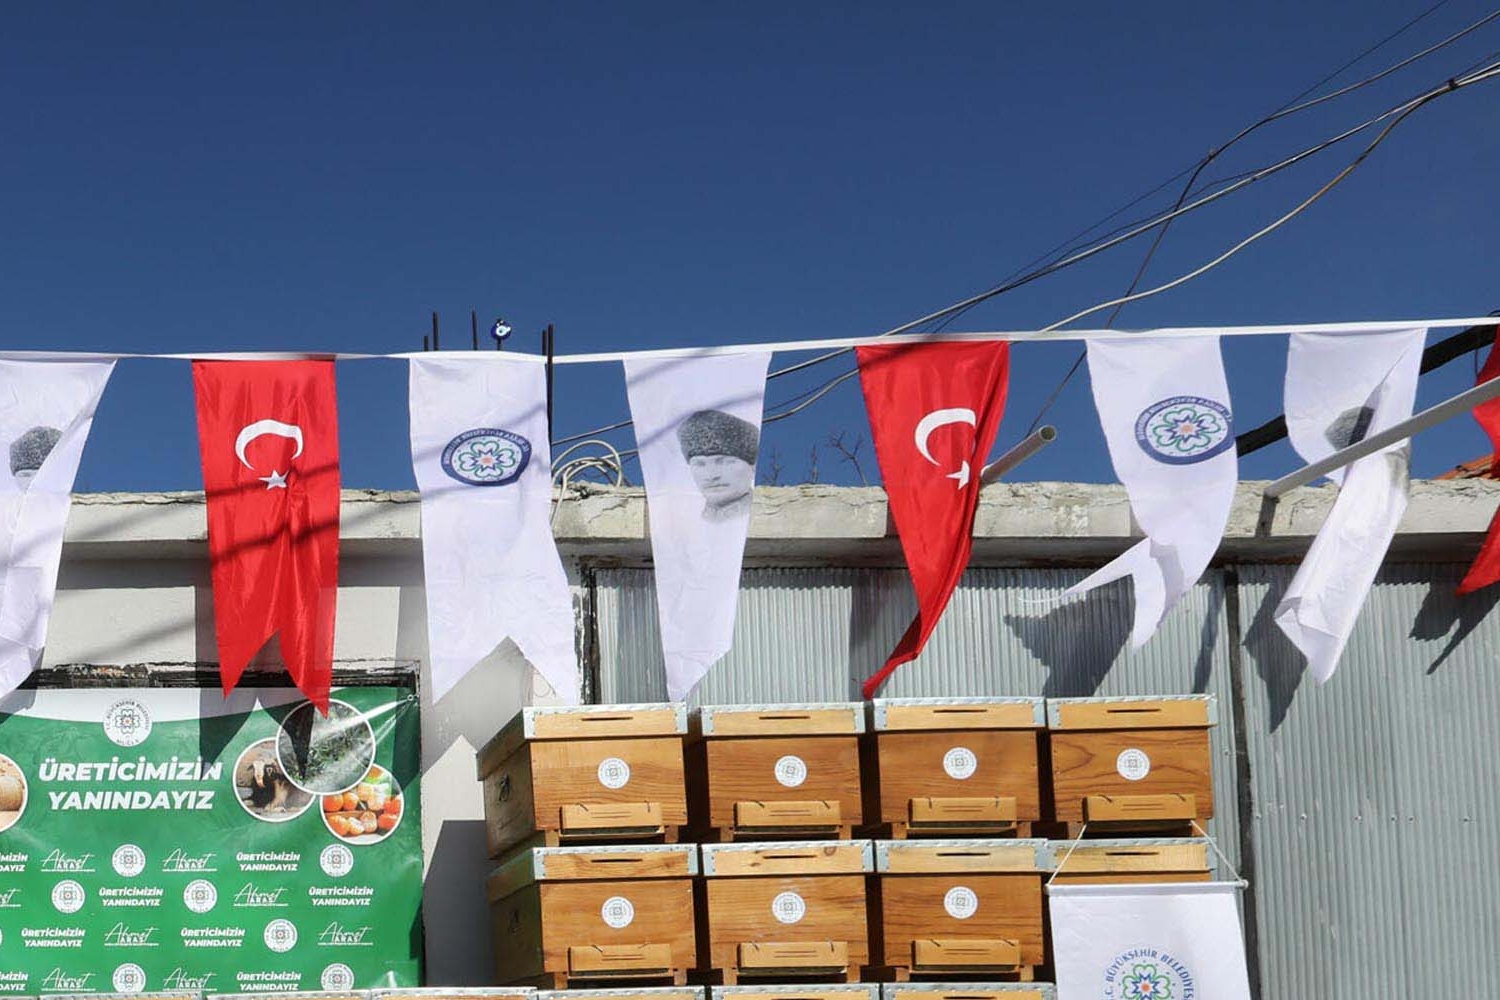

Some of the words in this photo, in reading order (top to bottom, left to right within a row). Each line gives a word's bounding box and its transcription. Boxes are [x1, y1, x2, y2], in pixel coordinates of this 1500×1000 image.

[38, 755, 223, 782] ÜRETİCİMİZİN
[48, 790, 216, 810] YANINDAYIZ
[236, 851, 300, 862] ÜRETİCİMİZİN
[239, 863, 298, 872] YANINDAYIZ
[99, 886, 164, 897] ÜRETİCİMİZİN
[308, 886, 374, 896] ÜRETİCİMİZİN
[101, 898, 160, 907] YANINDAYIZ
[312, 898, 371, 906] YANINDAYIZ
[21, 927, 86, 937] ÜRETİCİMİZİN
[180, 927, 246, 937] ÜRETİCİMİZİN
[24, 939, 82, 948] YANINDAYIZ
[183, 939, 242, 947] YANINDAYIZ
[236, 971, 301, 981] ÜRETİCİMİZİN
[239, 983, 299, 992] YANINDAYIZ
